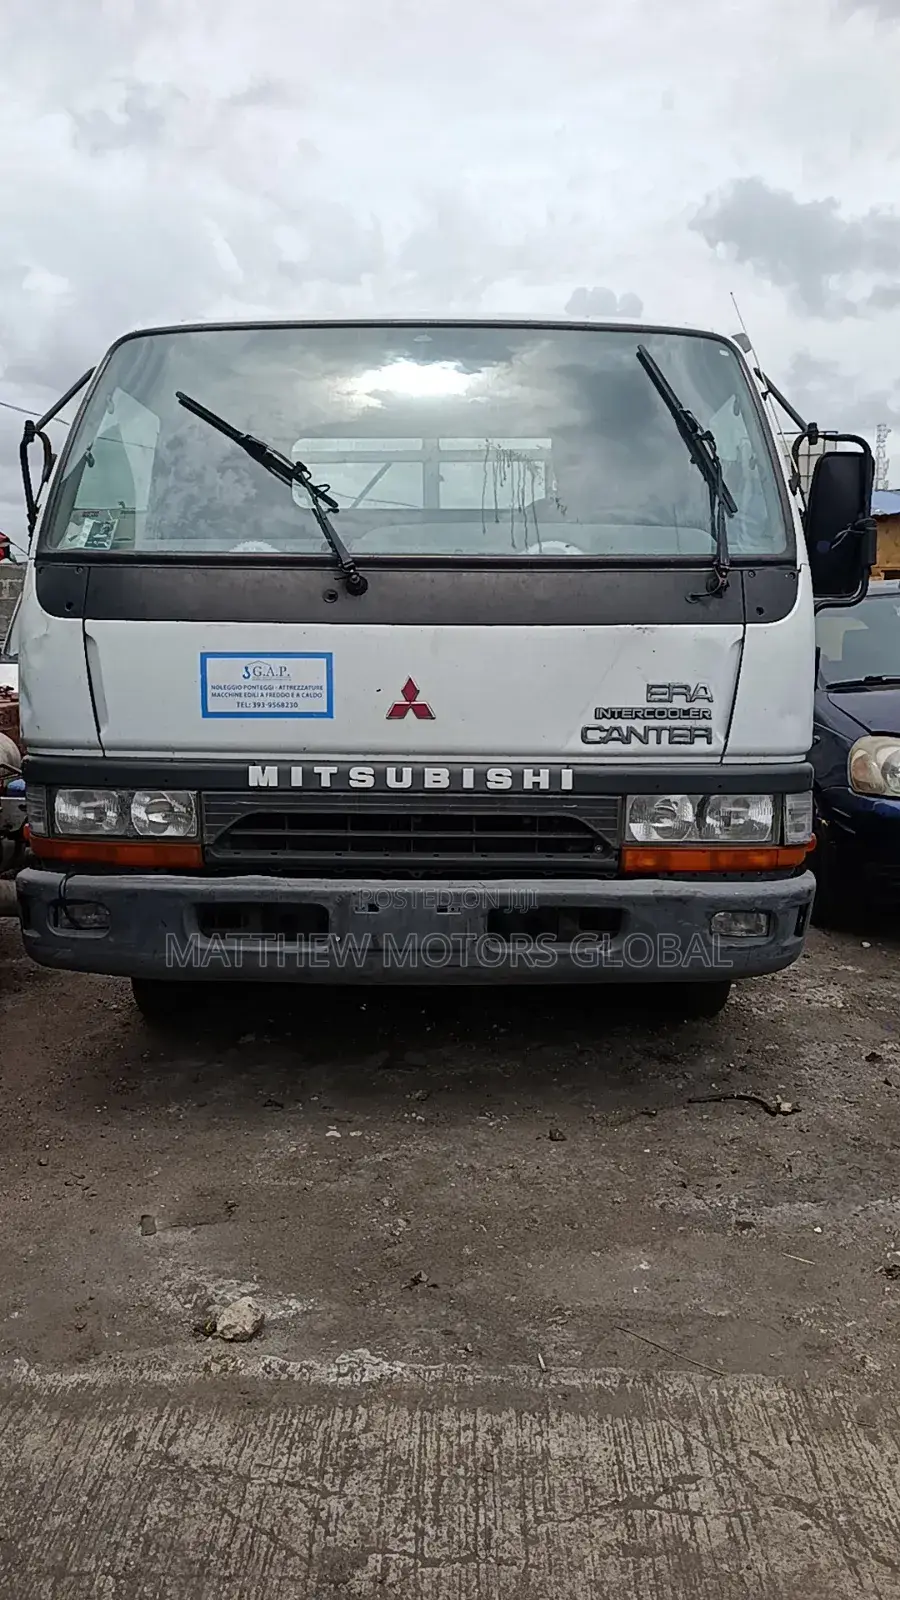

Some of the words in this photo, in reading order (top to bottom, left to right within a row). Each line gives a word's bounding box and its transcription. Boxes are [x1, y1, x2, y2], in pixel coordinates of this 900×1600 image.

[646, 682, 714, 703] ERA
[236, 701, 251, 709] TEL:
[594, 707, 713, 720] INTERCOOLER
[580, 724, 713, 745] CANTER
[248, 765, 573, 790] MITSUBISHI
